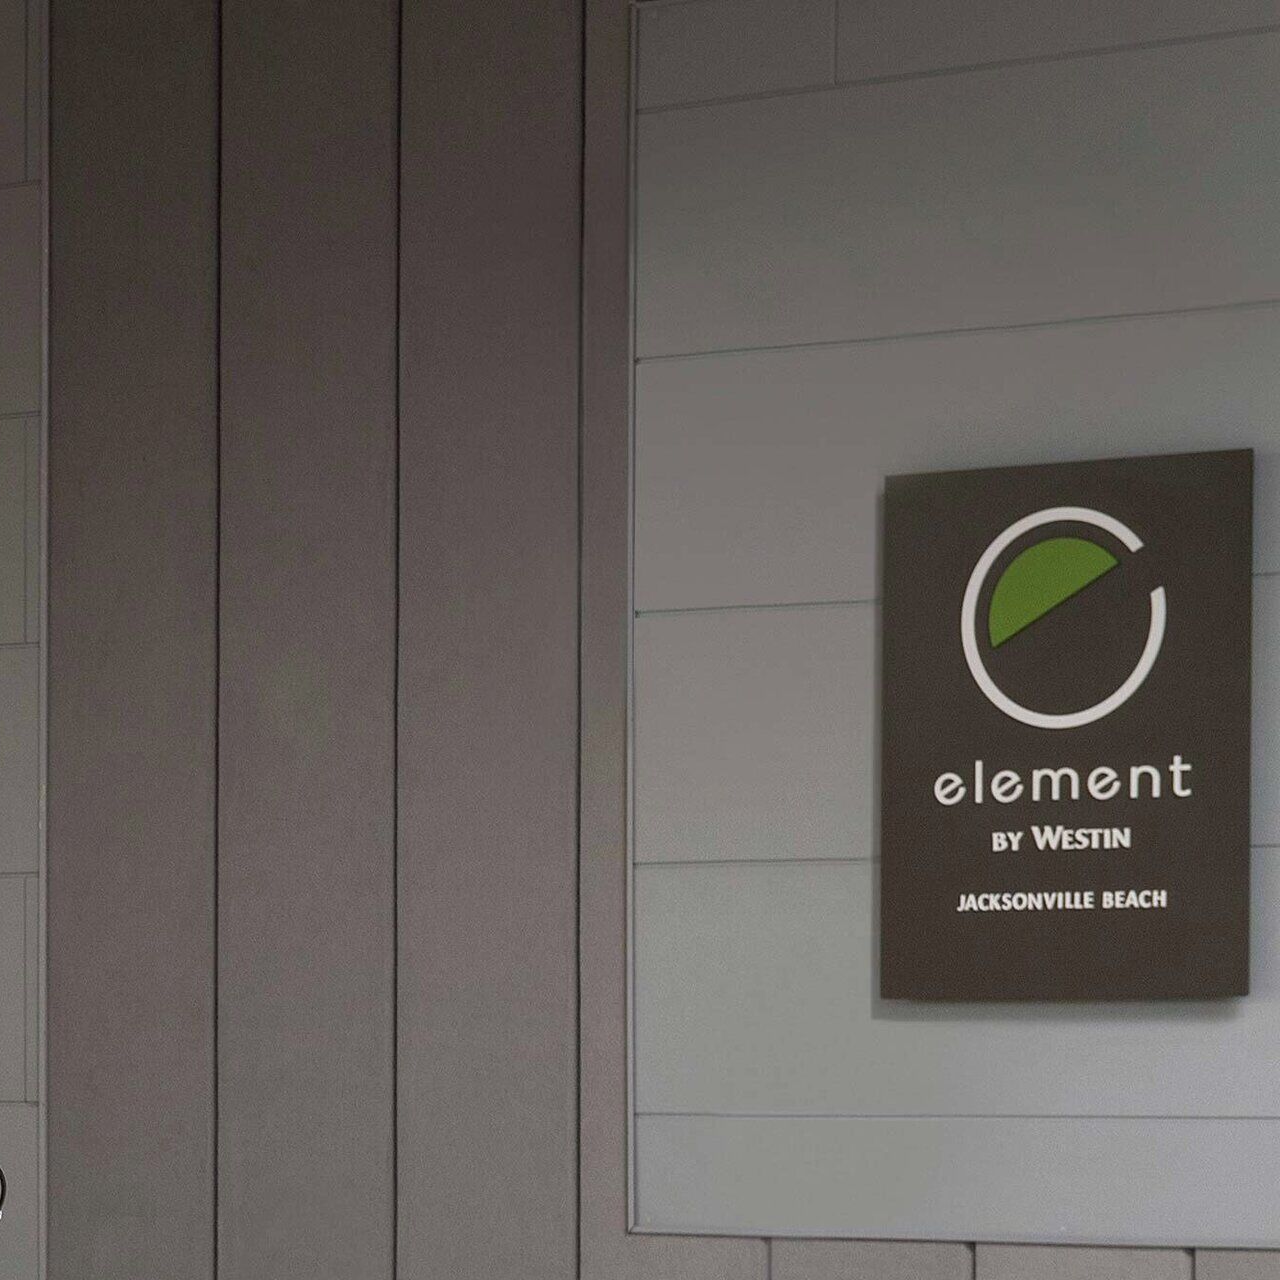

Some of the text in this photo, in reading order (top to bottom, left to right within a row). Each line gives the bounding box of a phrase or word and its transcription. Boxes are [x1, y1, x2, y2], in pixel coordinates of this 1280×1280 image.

[933, 754, 1192, 806] element
[991, 825, 1132, 853] BY WESTIN
[956, 889, 1168, 912] JACKSONVILLE BEACH
